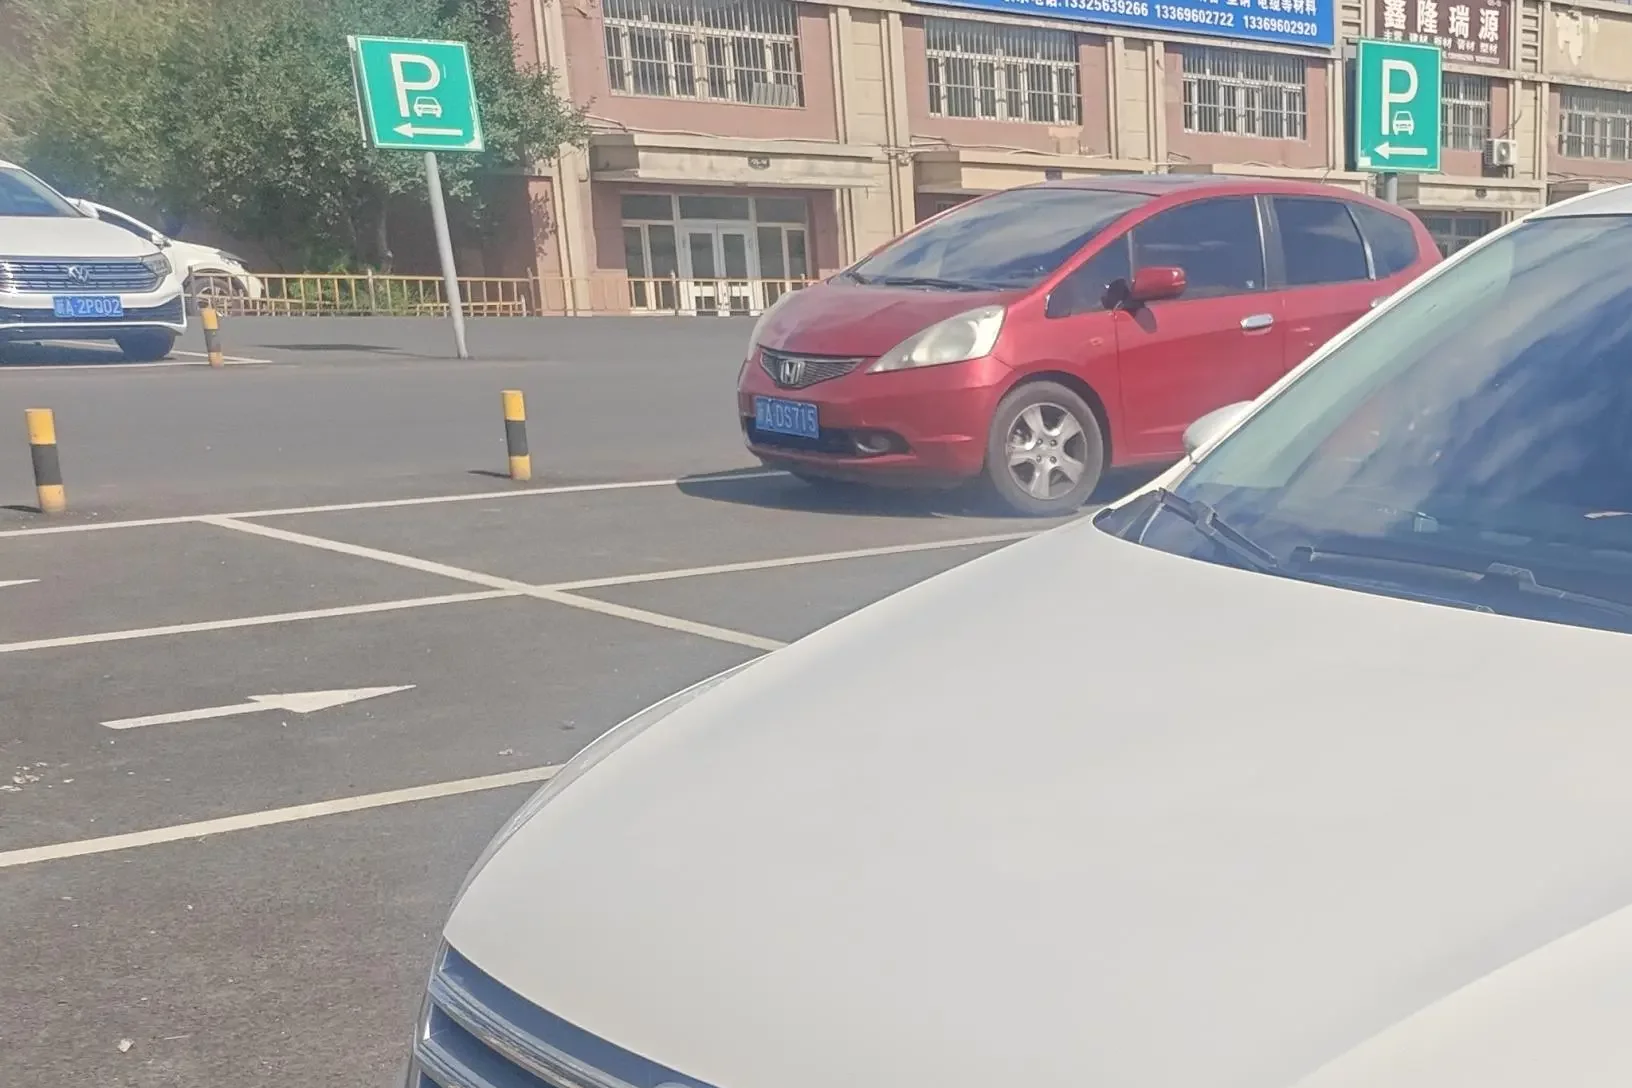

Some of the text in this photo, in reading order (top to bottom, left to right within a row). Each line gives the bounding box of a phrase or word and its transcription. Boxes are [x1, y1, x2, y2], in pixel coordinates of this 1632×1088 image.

[1154, 5, 1235, 28] 13369602722
[1242, 15, 1317, 37] 13369602920
[390, 53, 440, 117] P
[1381, 59, 1418, 135] P
